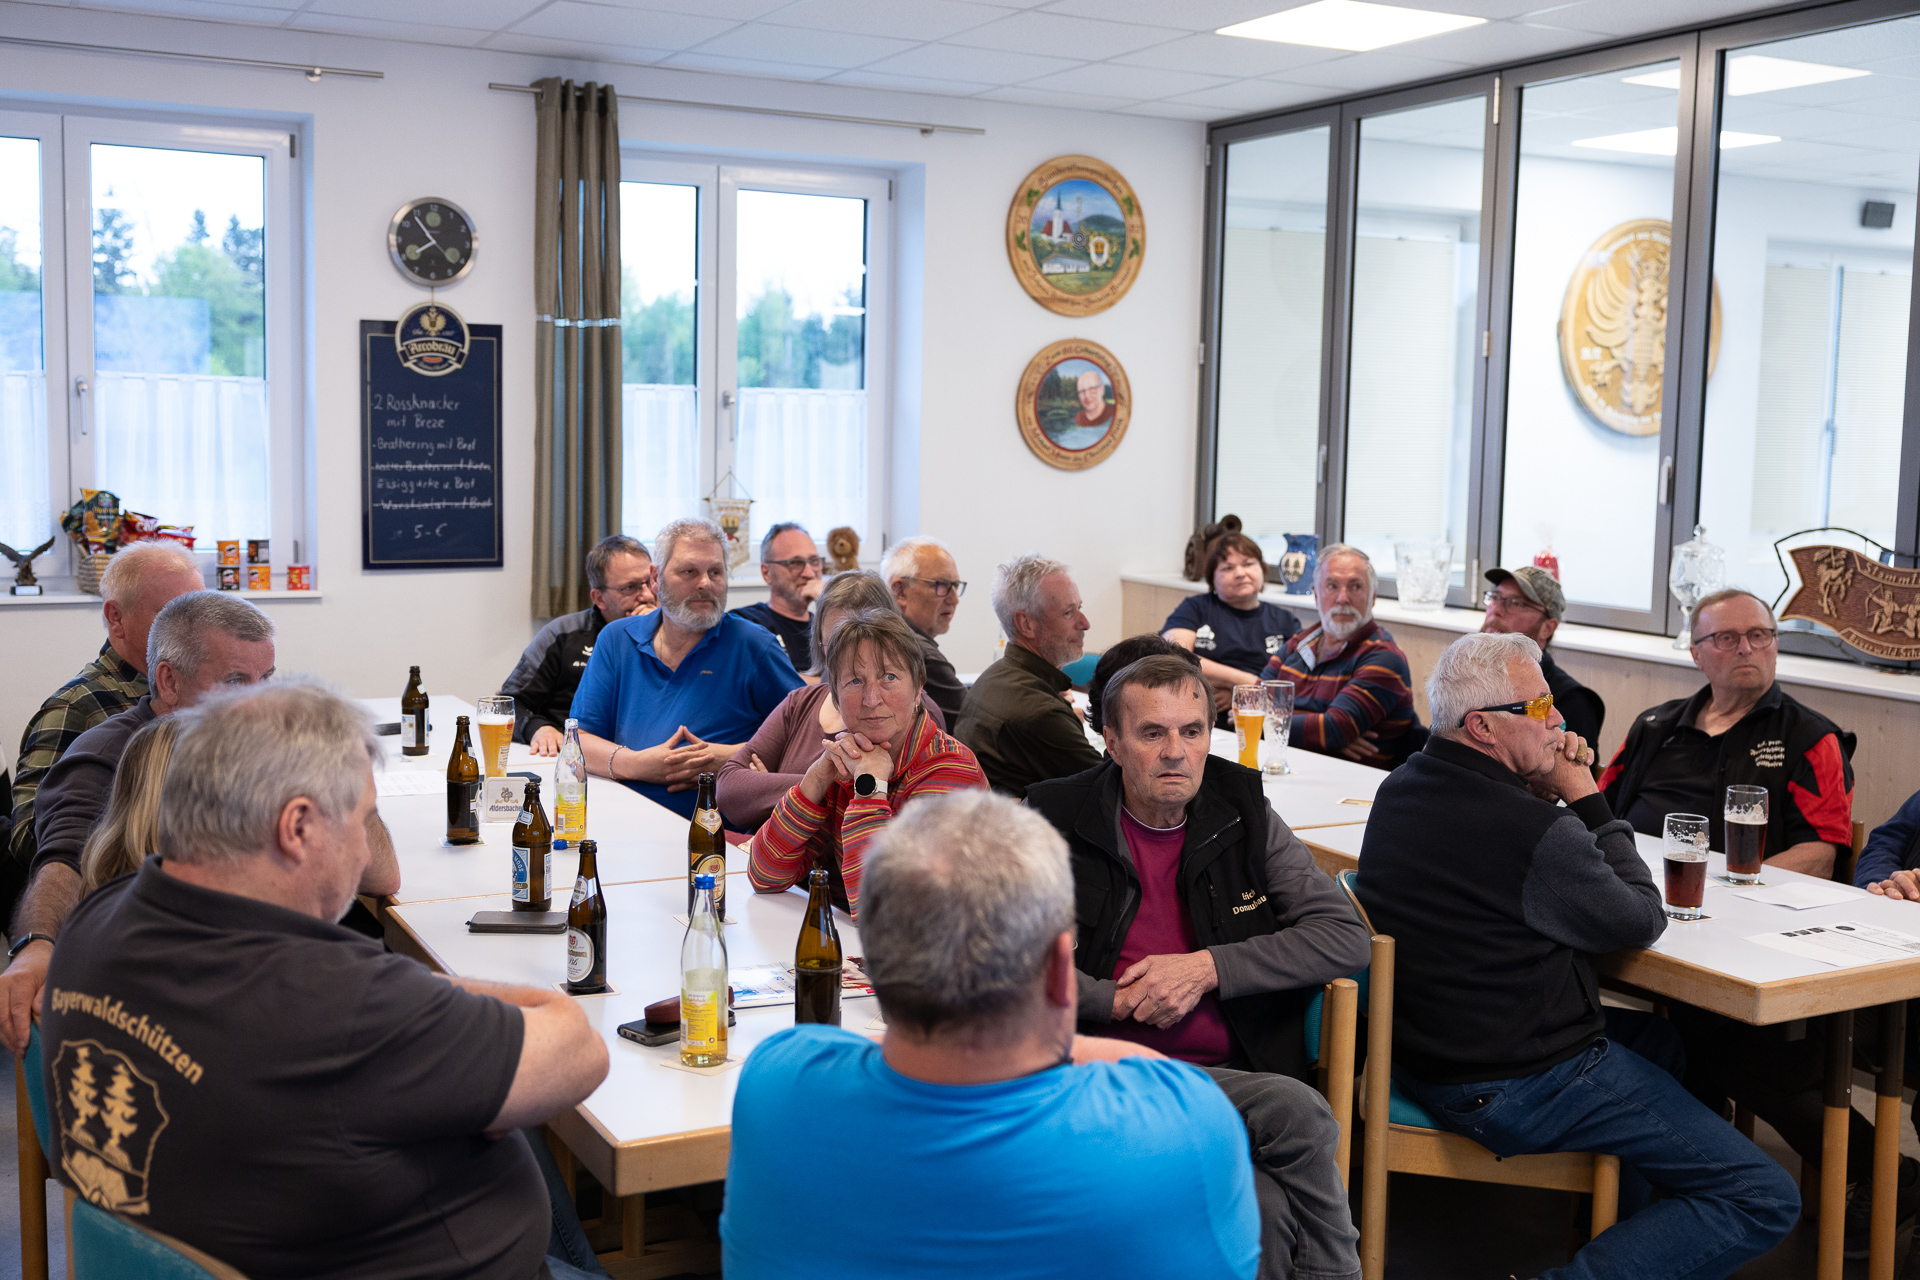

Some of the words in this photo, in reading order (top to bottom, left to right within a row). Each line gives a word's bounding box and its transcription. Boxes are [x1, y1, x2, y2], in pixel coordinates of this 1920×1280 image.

[429, 204, 439, 212] 12
[402, 220, 411, 228] 10
[386, 415, 407, 427] mit
[414, 413, 446, 429] Breze
[1862, 562, 1920, 585] Stammt
[489, 804, 522, 812] Aldersbache
[52, 988, 204, 1085] Bayerwaldschützen
